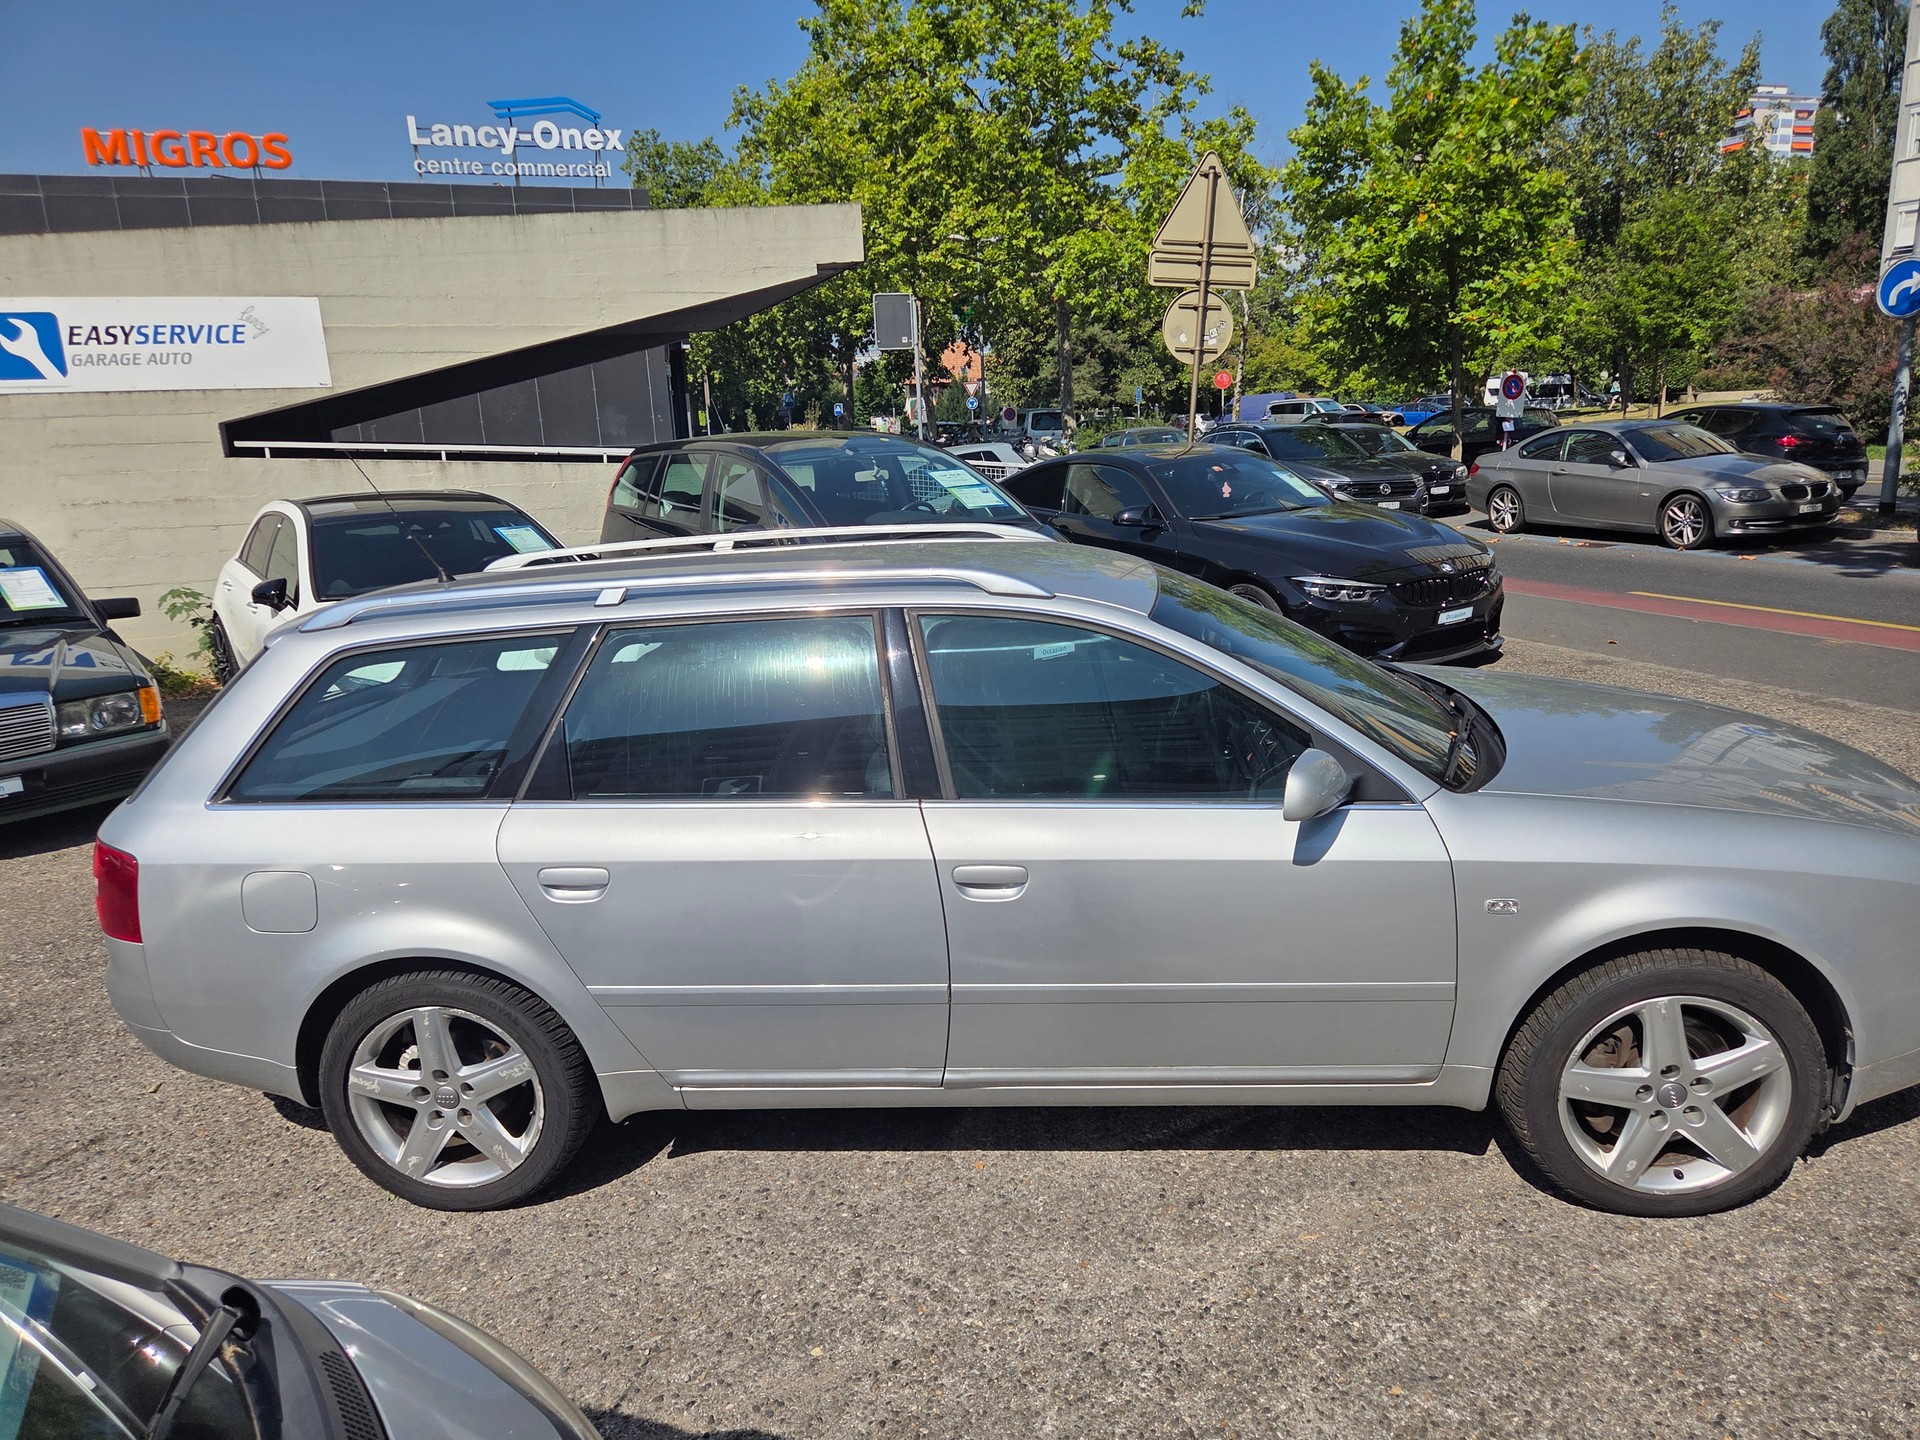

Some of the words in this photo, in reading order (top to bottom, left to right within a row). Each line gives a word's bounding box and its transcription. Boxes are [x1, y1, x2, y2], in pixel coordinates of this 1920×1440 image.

[406, 115, 625, 155] Lancy-Onex
[80, 127, 293, 170] MIGROS
[413, 157, 484, 175] centre
[491, 159, 612, 177] commercial
[237, 305, 270, 339] Lancy
[68, 323, 247, 346] EASYSERVICE
[71, 353, 142, 367] GARAGE
[146, 352, 193, 366] AUTO
[1445, 611, 1467, 621] Occasion
[1042, 645, 1067, 656] Occasion
